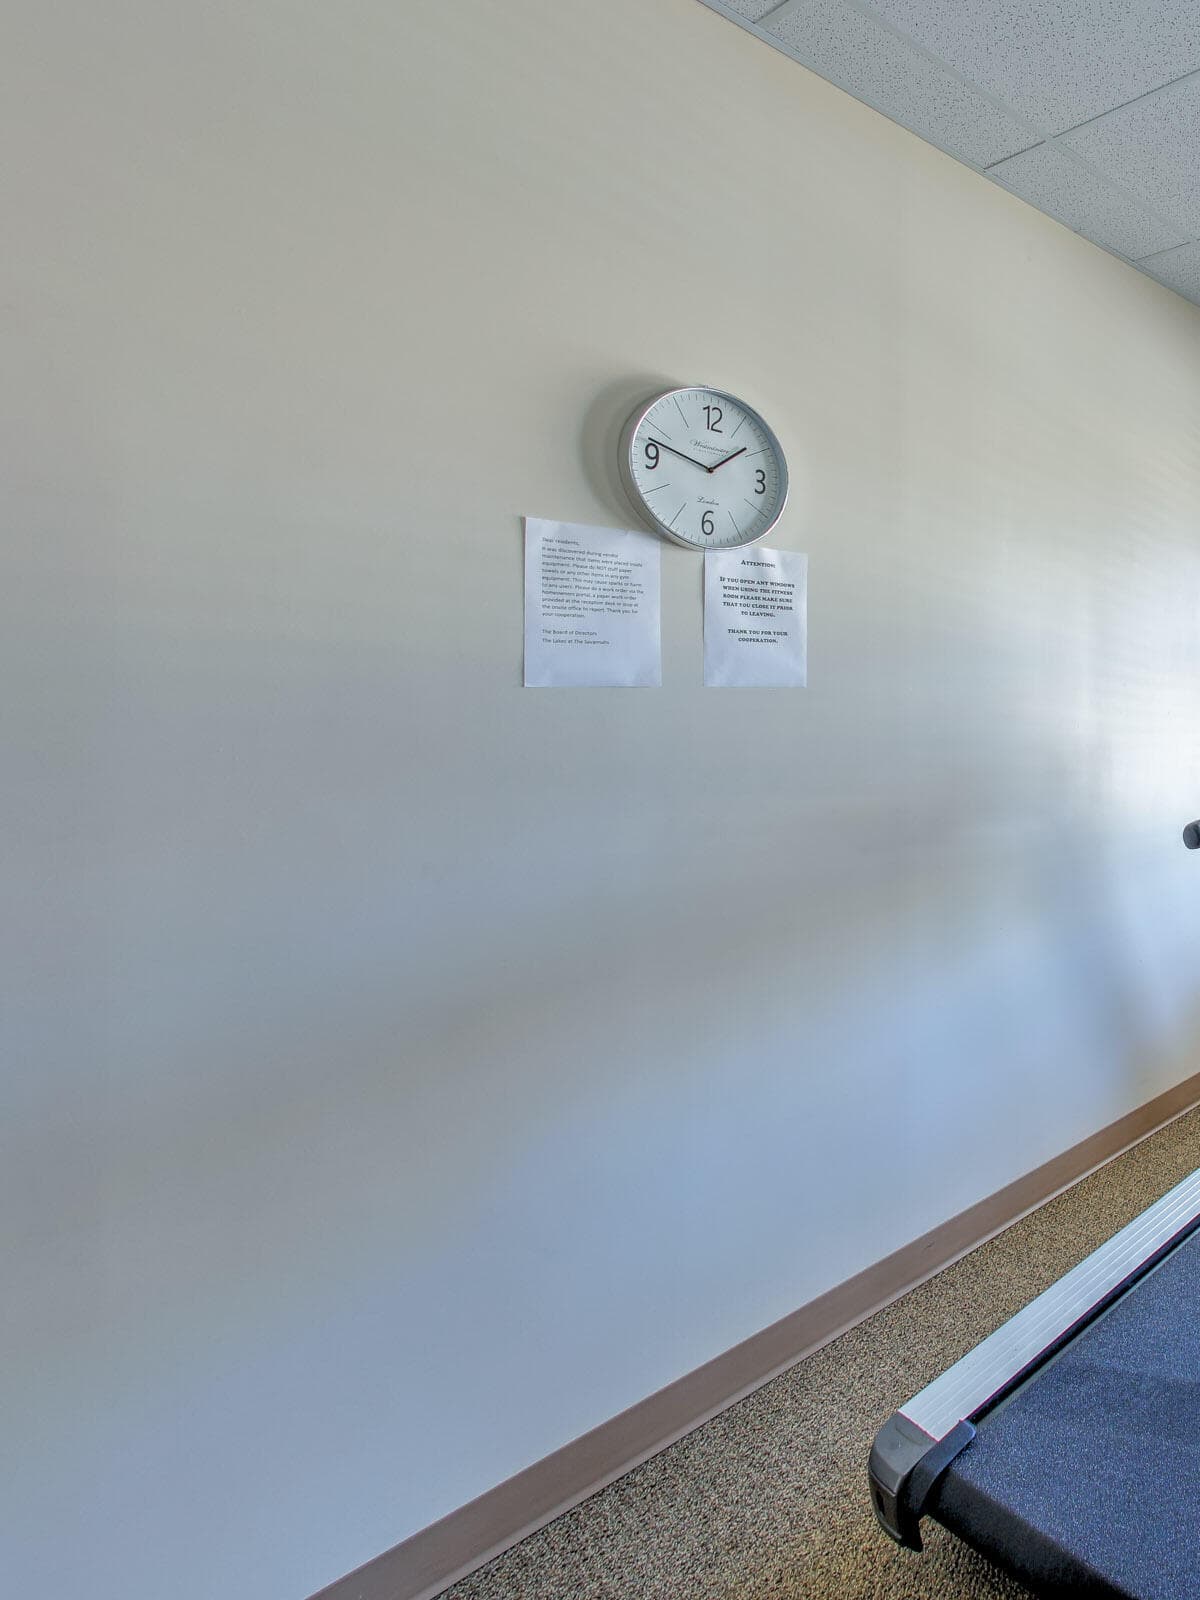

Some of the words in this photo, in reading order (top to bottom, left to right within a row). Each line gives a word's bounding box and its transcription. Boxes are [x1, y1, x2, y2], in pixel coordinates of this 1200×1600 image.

[702, 405, 723, 434] 12
[645, 442, 659, 470] 9
[754, 469, 766, 495] 3
[701, 510, 714, 535] 6
